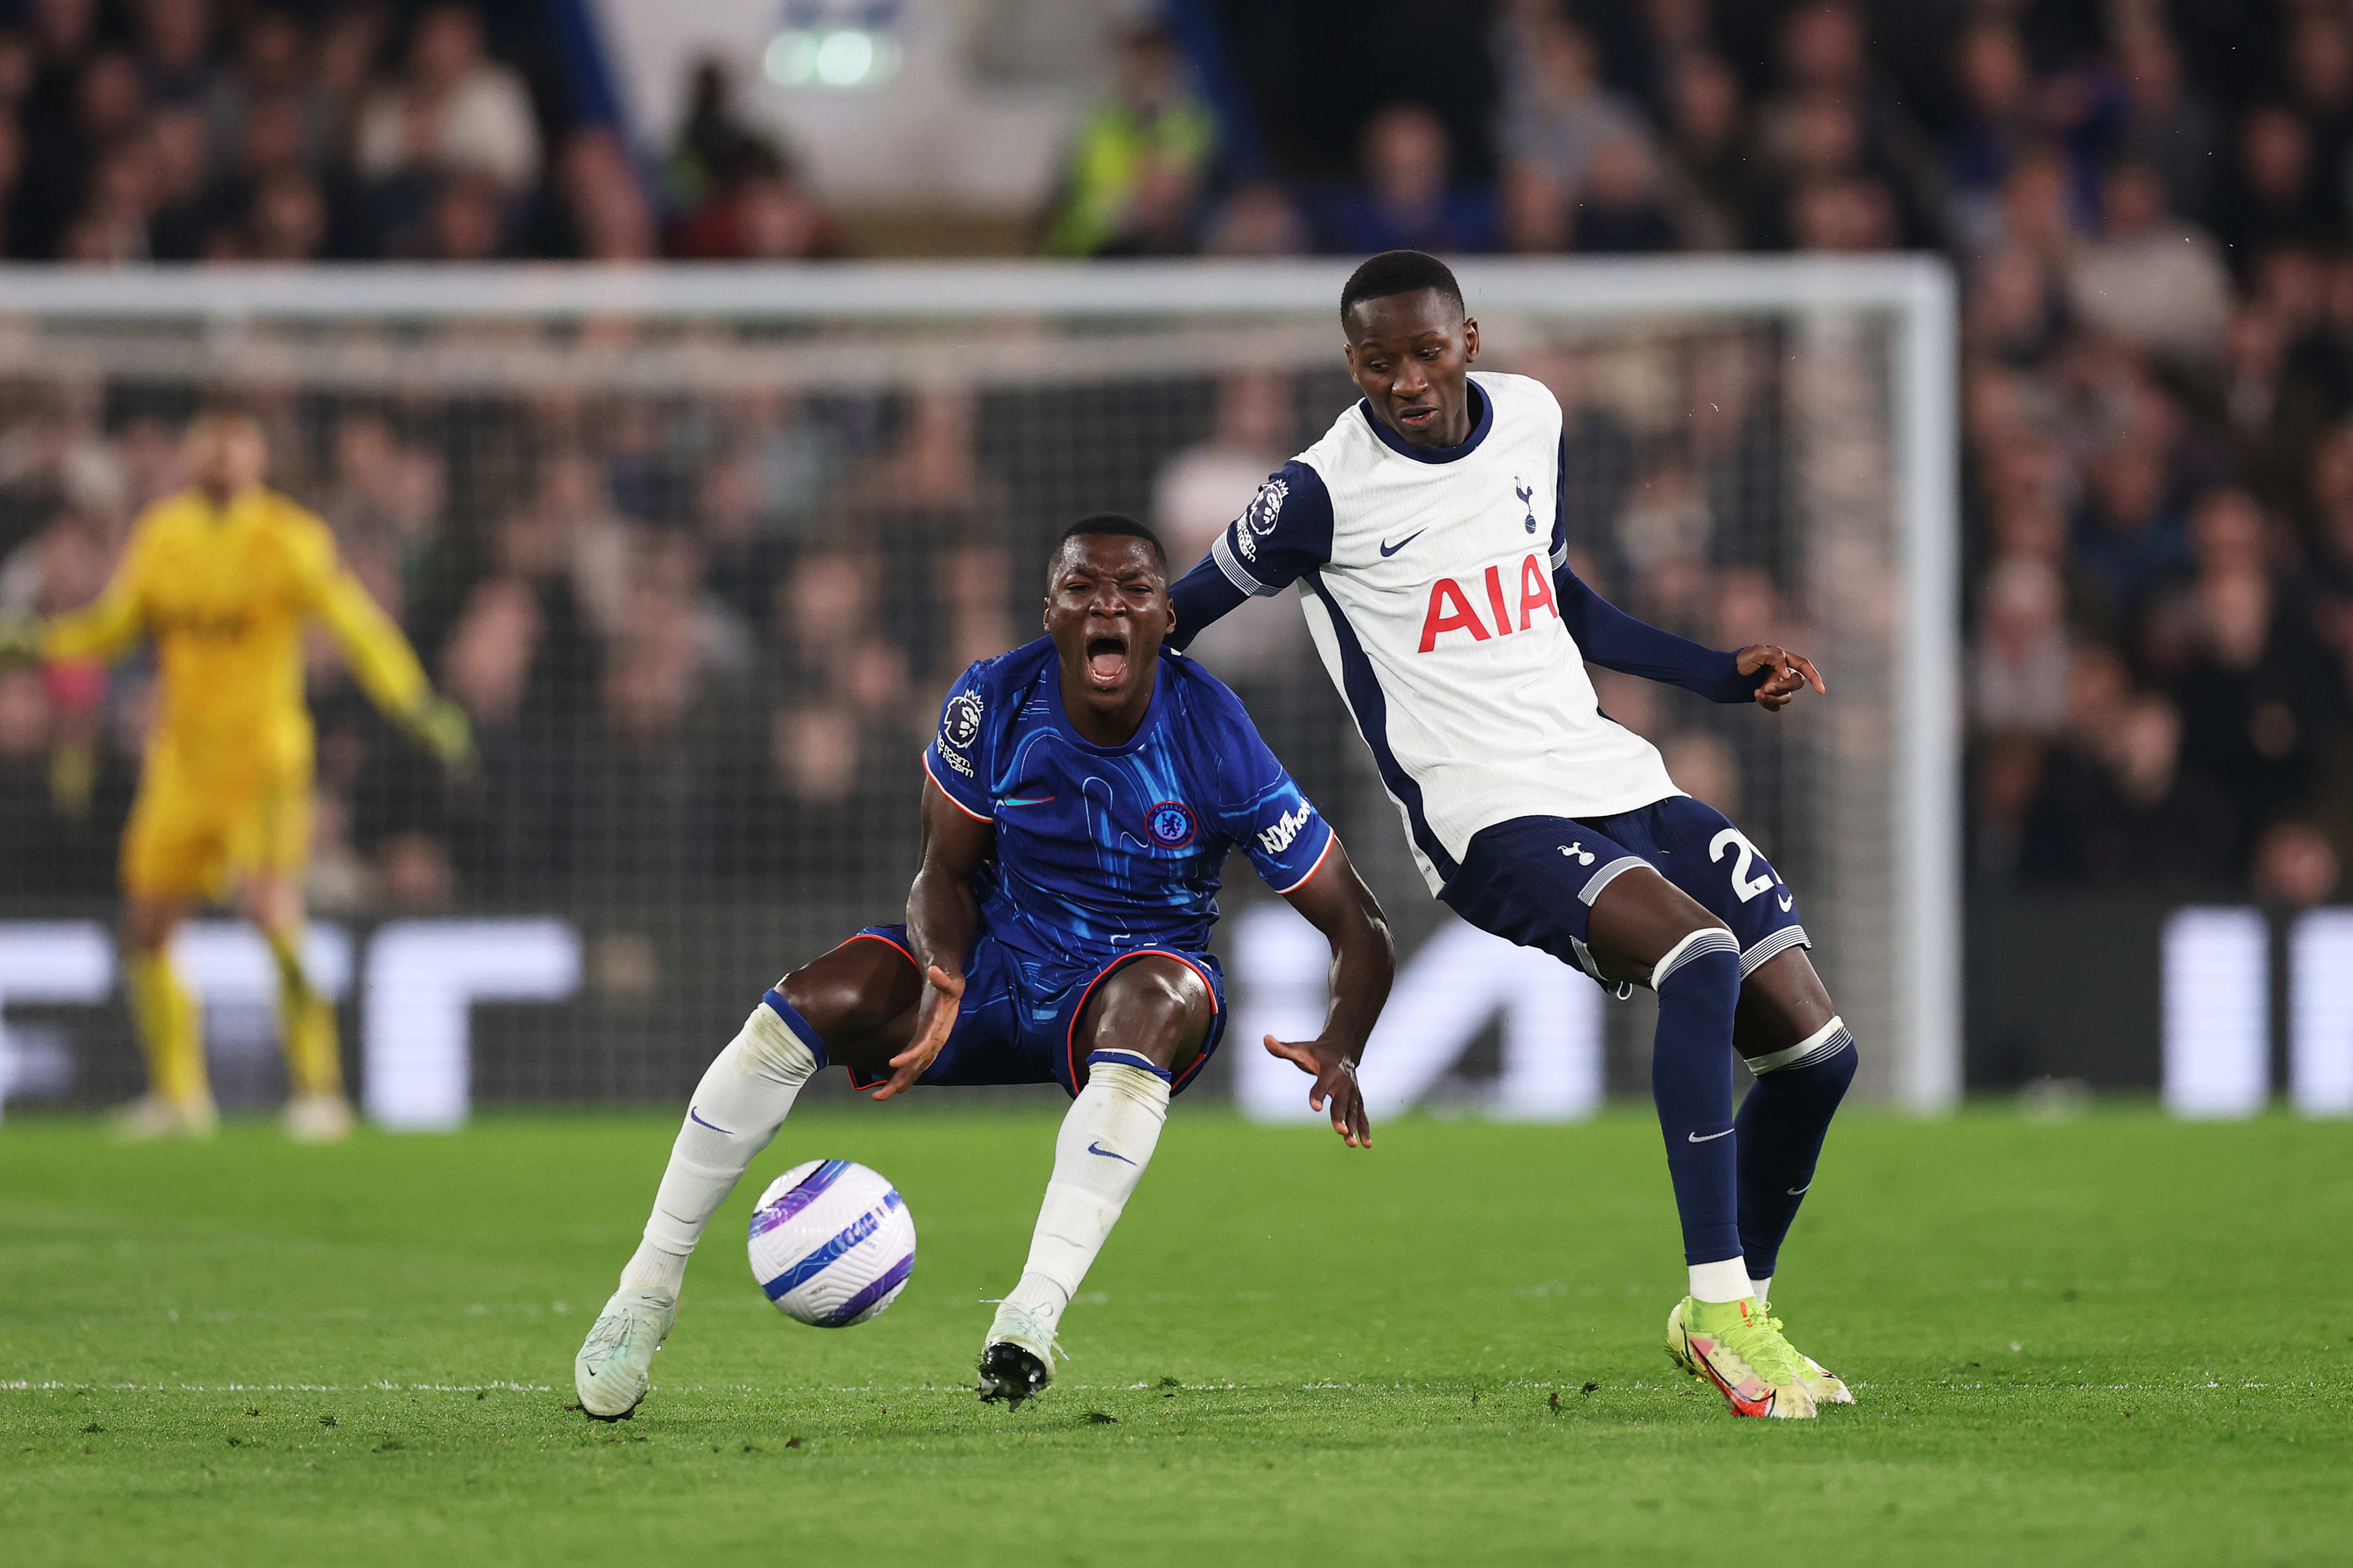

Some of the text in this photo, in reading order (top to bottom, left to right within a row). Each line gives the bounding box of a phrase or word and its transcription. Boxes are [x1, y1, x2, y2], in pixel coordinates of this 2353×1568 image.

[1417, 554, 1558, 654] AIA
[942, 751, 974, 778] racism
[944, 744, 970, 768] room
[1155, 804, 1186, 815] CHELSEA
[1257, 809, 1294, 842] LIVE
[1264, 797, 1311, 855] NATION
